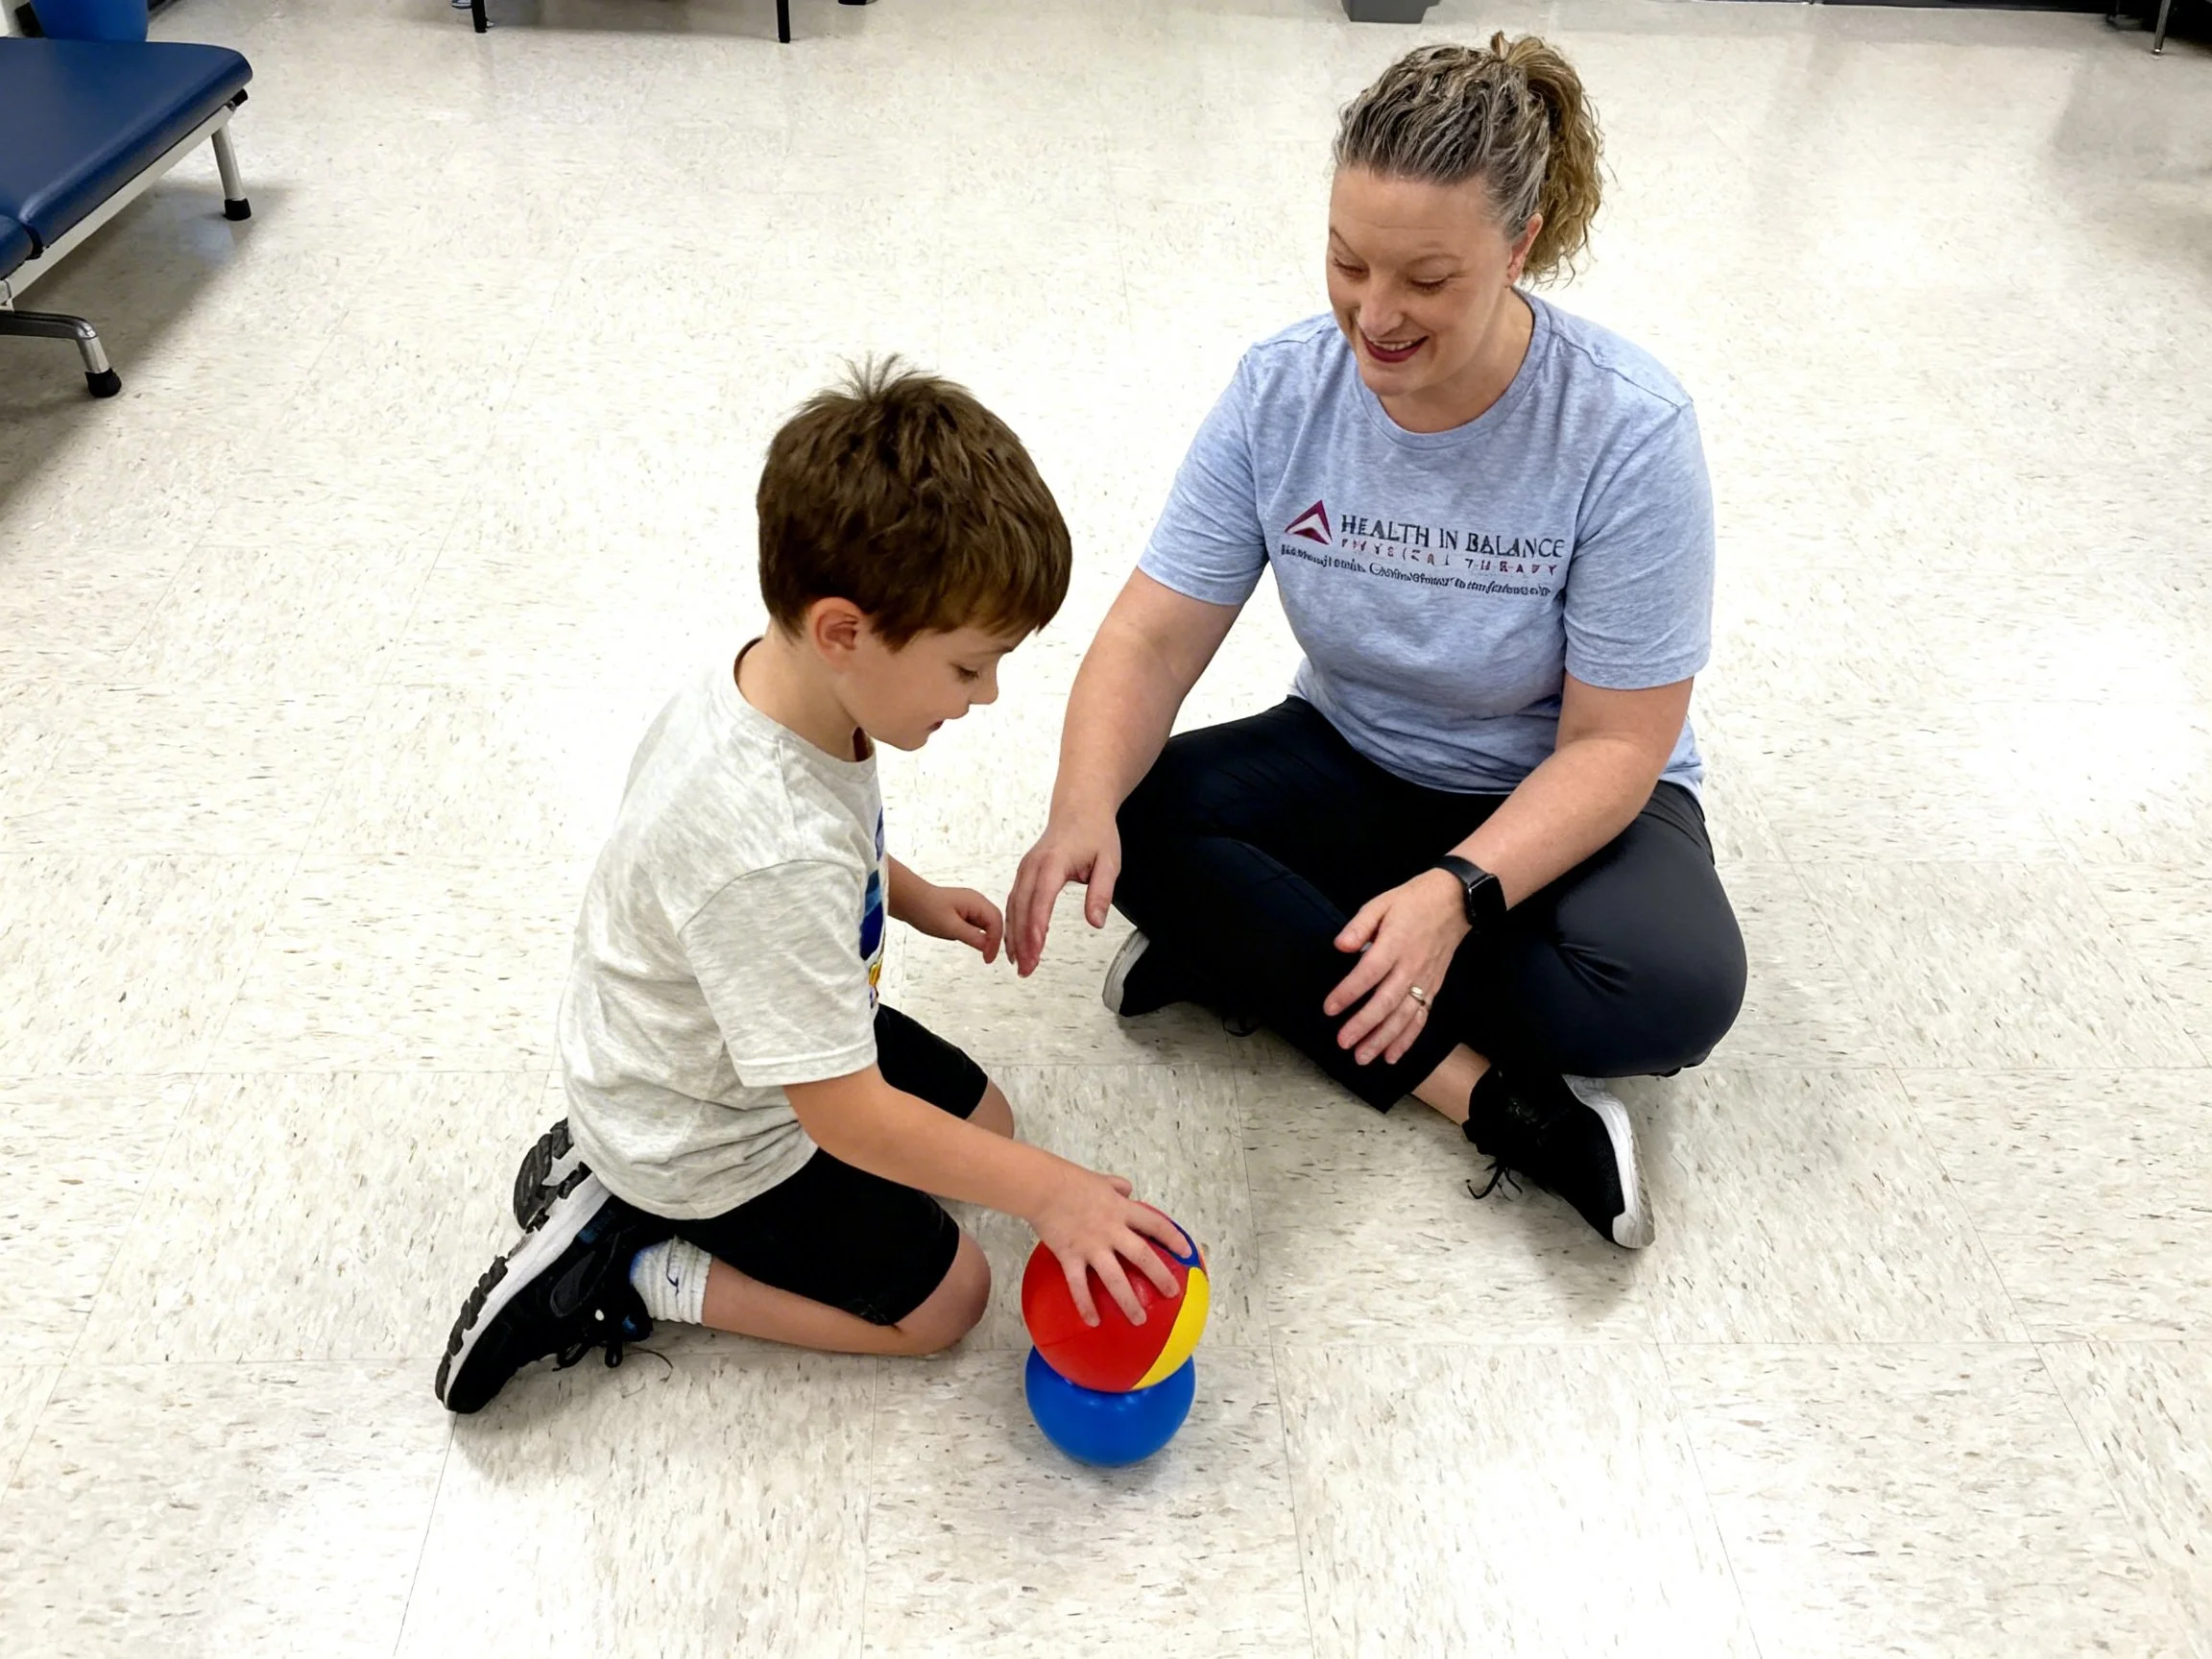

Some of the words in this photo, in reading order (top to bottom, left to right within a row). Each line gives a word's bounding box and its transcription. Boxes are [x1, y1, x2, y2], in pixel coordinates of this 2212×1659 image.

[1341, 514, 1430, 547] HEALTH
[1439, 529, 1458, 550] IN
[1465, 533, 1566, 558] BALANCE
